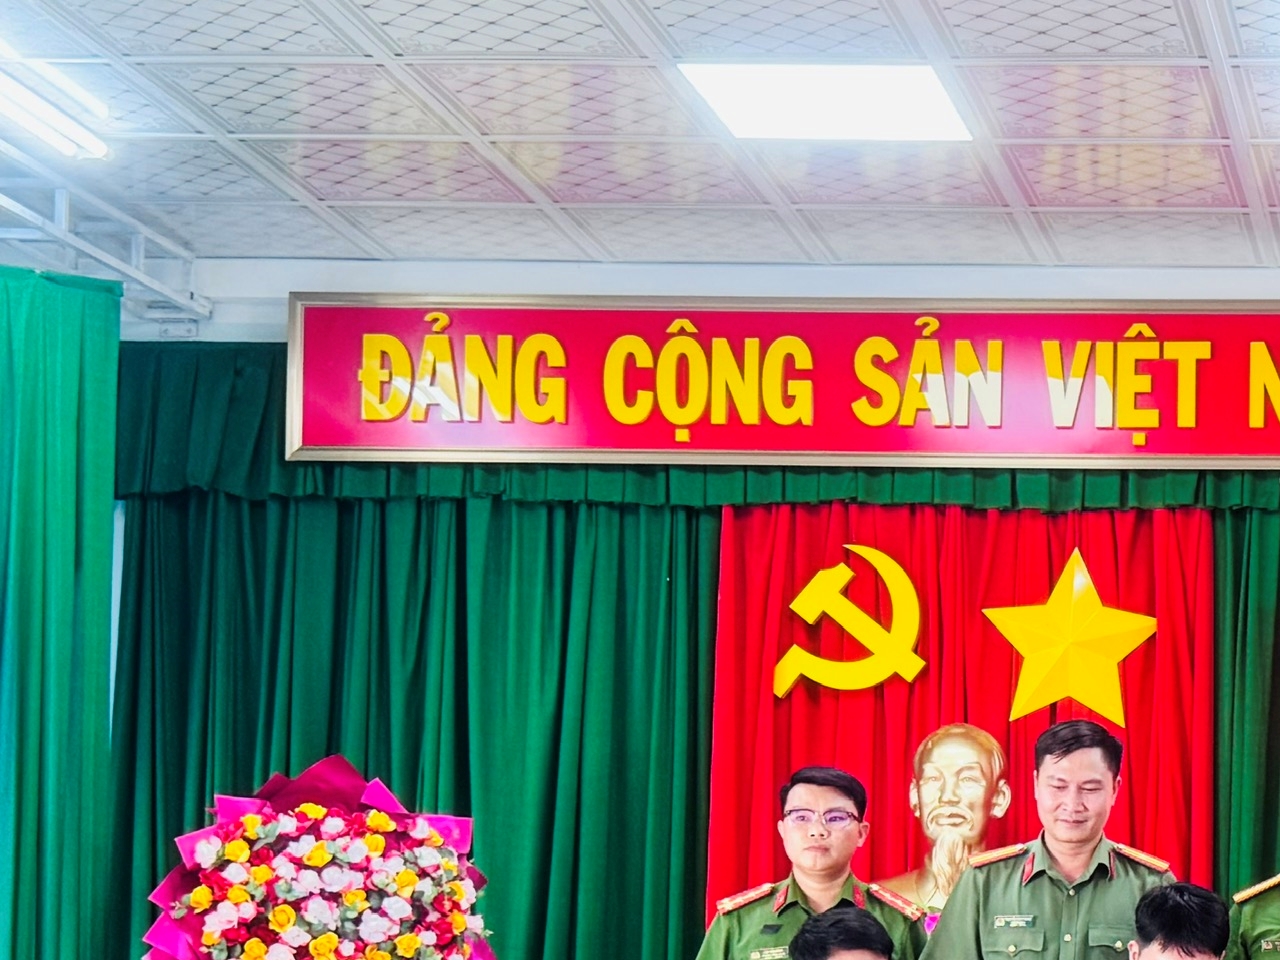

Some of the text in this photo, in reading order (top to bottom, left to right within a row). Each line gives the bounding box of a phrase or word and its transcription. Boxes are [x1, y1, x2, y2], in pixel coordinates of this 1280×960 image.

[358, 312, 567, 425] ĐẢNG
[603, 318, 814, 443] CỘNG
[851, 316, 1003, 430] SẢN
[1042, 322, 1212, 446] VIỆT
